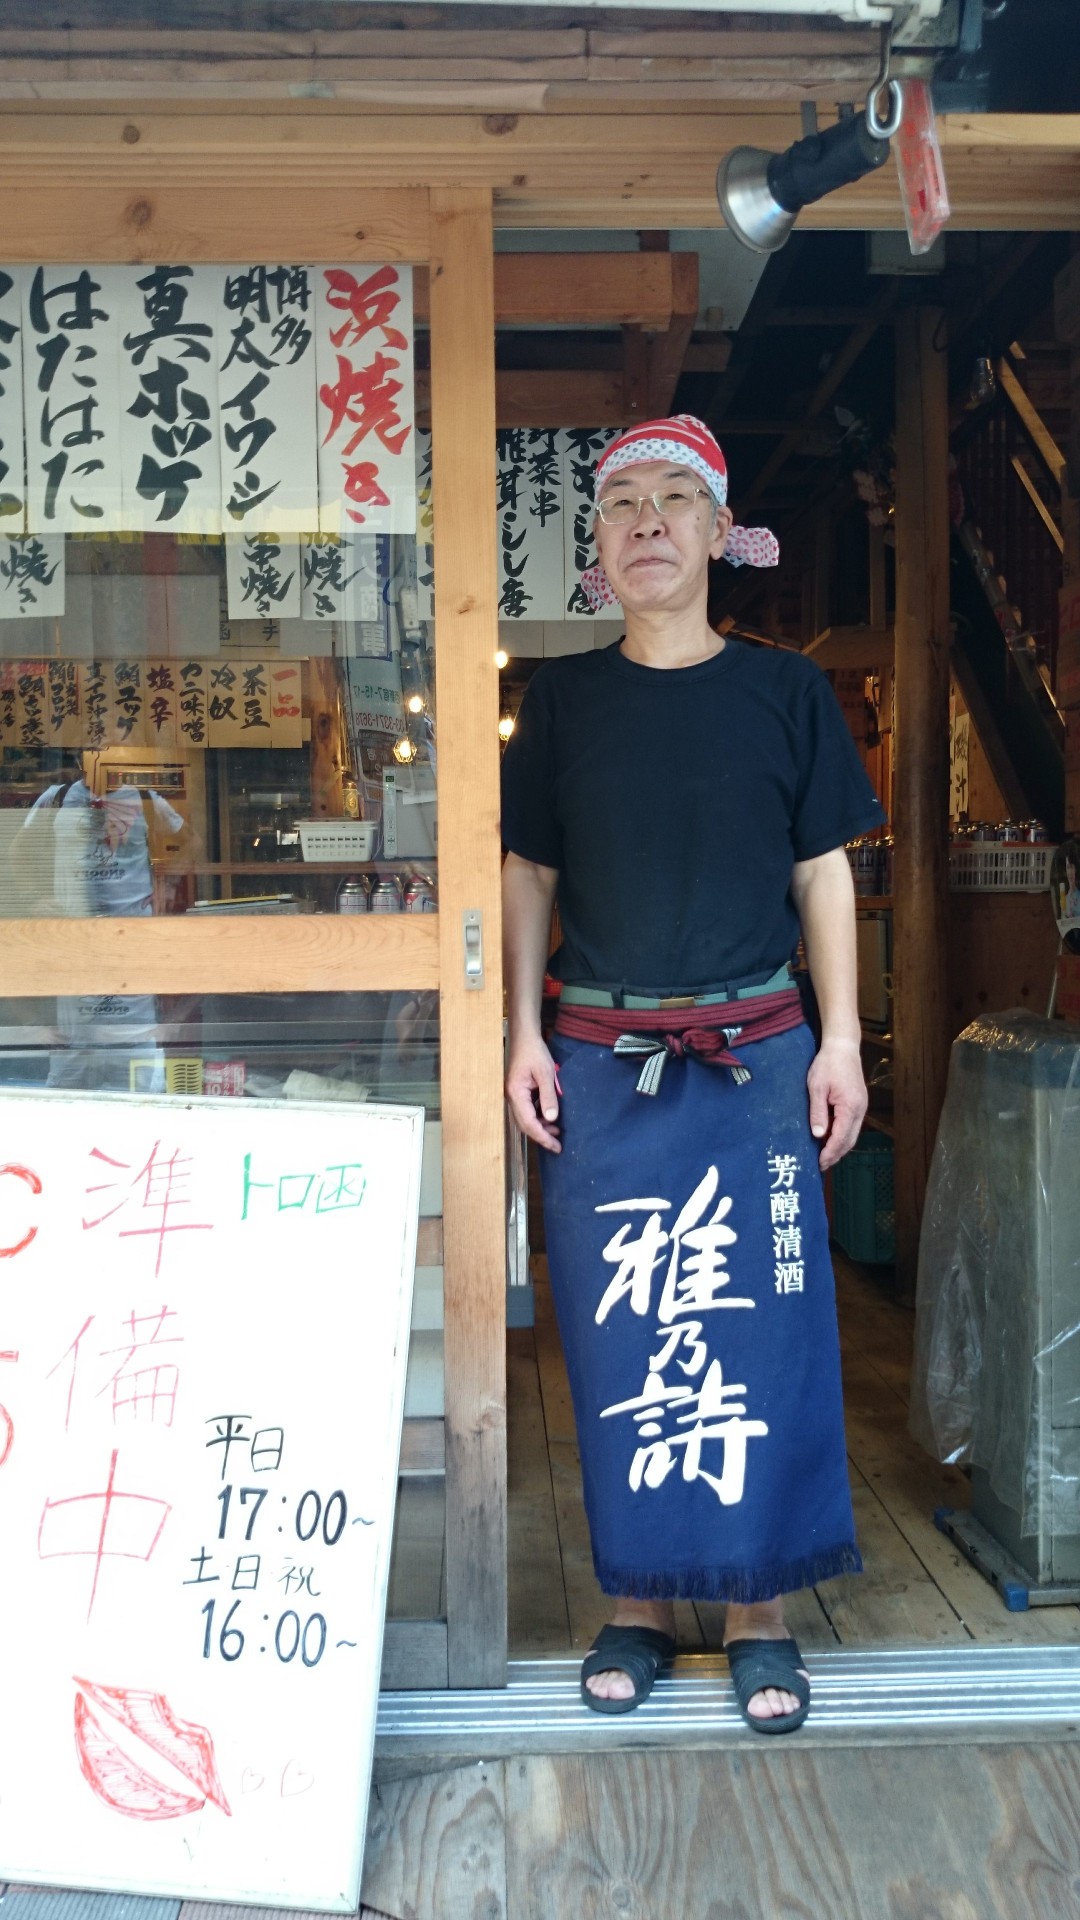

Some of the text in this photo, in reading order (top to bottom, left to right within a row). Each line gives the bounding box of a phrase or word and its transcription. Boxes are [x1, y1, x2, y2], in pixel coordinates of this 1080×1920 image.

[30, 265, 109, 520] はたはた
[123, 265, 213, 522] 真ホッケ
[320, 265, 412, 524] 浜焼き
[0, 533, 62, 614] 焼き
[147, 664, 176, 735] 塩辛
[208, 662, 239, 721] 冷奴
[240, 663, 271, 730] 茶豆
[272, 668, 301, 718] 一品
[241, 1153, 367, 1220] トロ函
[767, 1154, 805, 1294] 芳醇清酒
[204, 1414, 285, 1480] 平日
